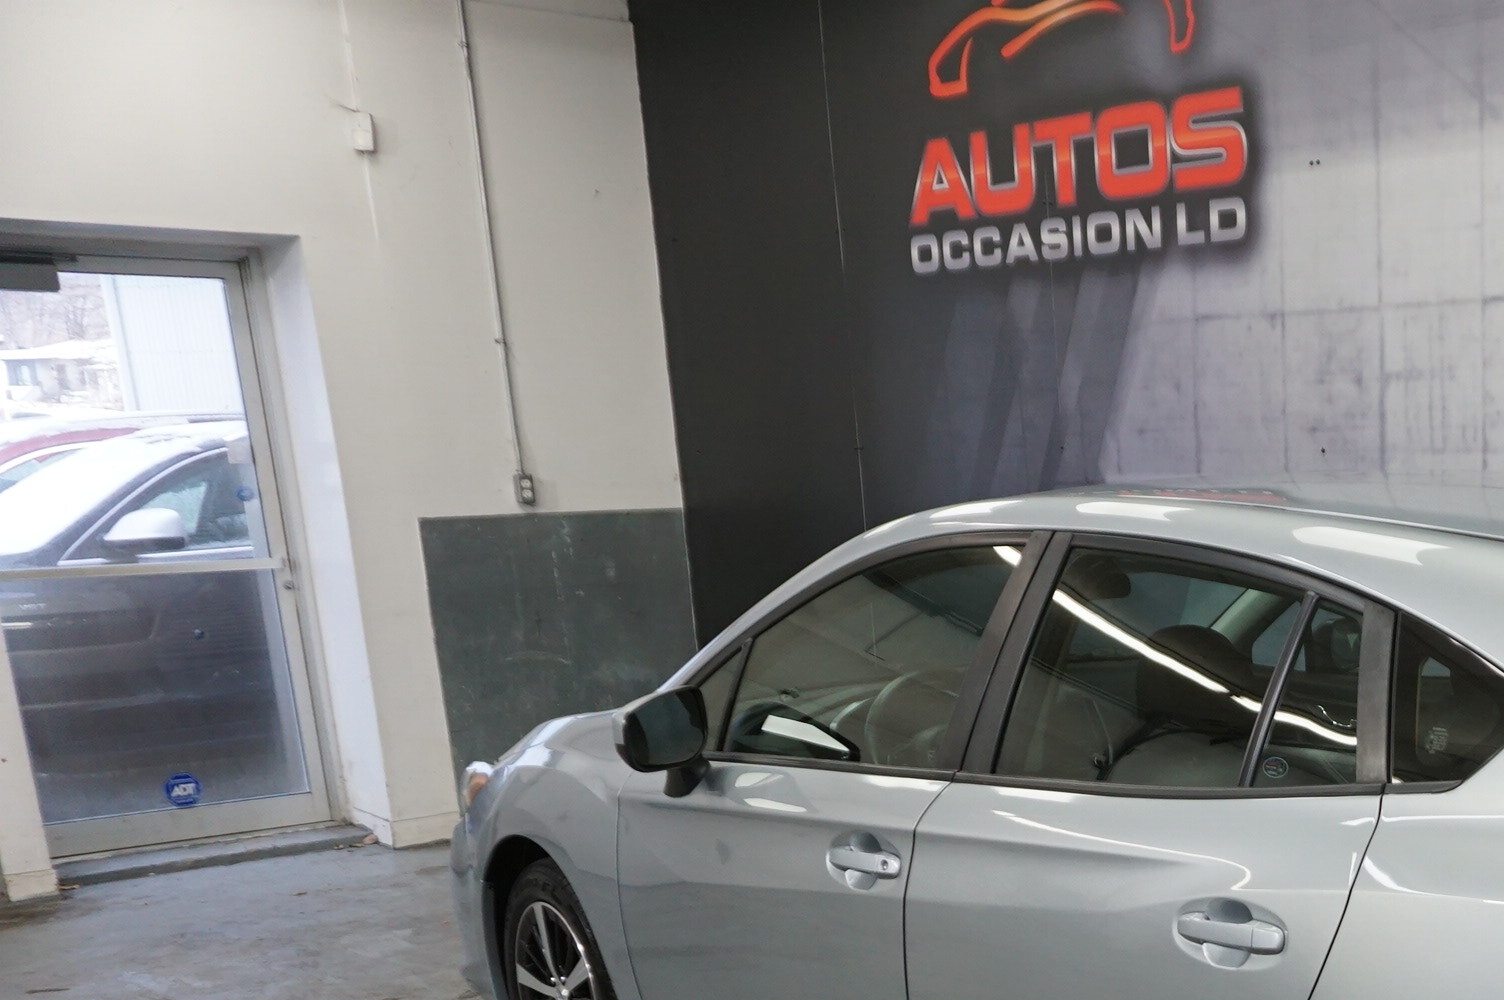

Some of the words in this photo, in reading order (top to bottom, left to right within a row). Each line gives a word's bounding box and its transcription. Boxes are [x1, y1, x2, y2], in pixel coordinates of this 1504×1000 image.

[910, 86, 1247, 227] AUTOS
[910, 204, 1162, 275] OCCASION
[1177, 196, 1247, 246] LD
[170, 782, 196, 797] ADT
